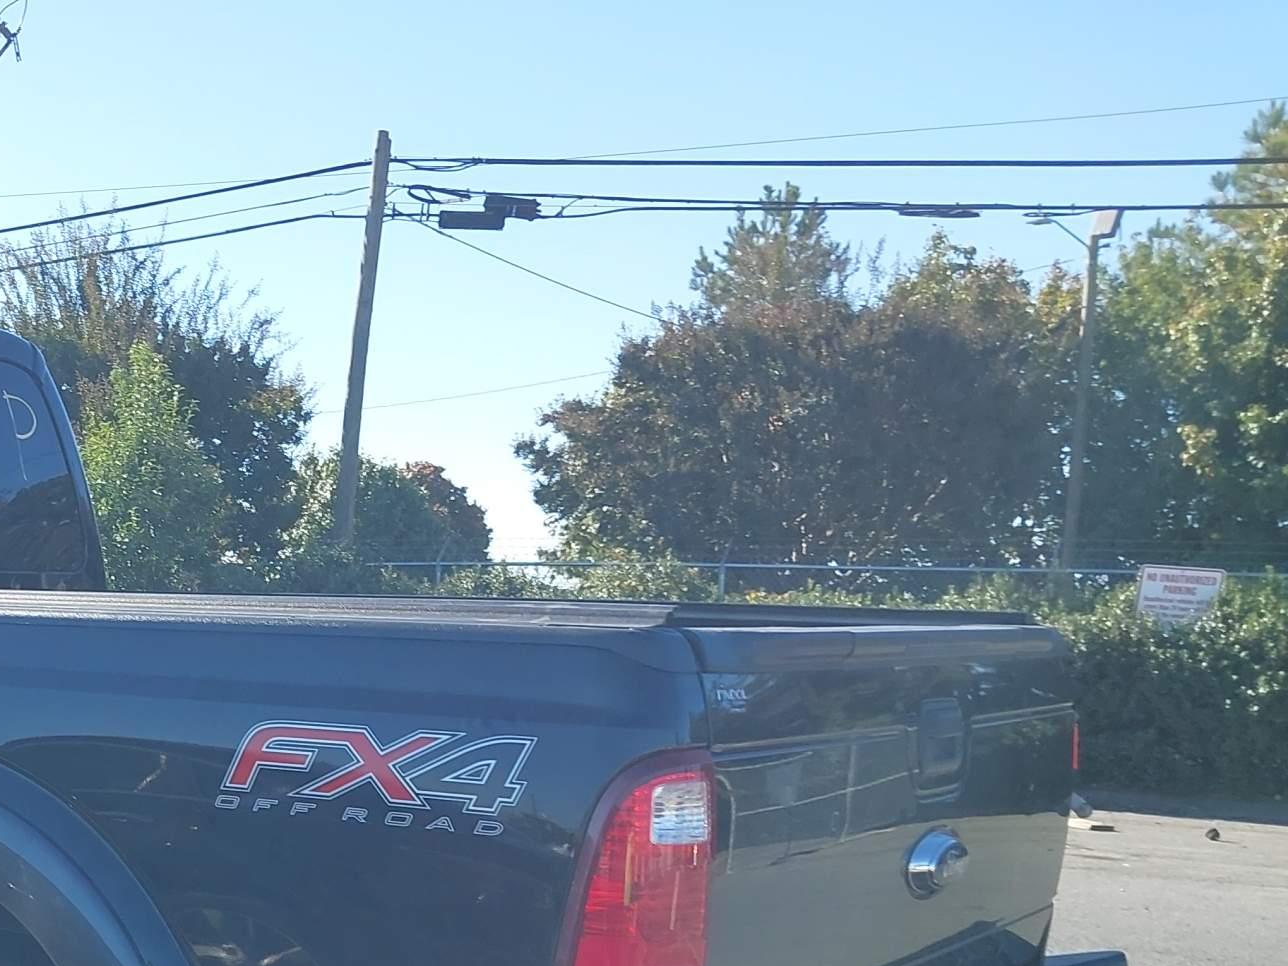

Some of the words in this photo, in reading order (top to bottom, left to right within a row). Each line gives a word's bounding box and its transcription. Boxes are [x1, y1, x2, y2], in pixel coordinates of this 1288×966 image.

[220, 719, 539, 816] FX4
[214, 794, 318, 816] OFF
[341, 807, 505, 837] ROAD
